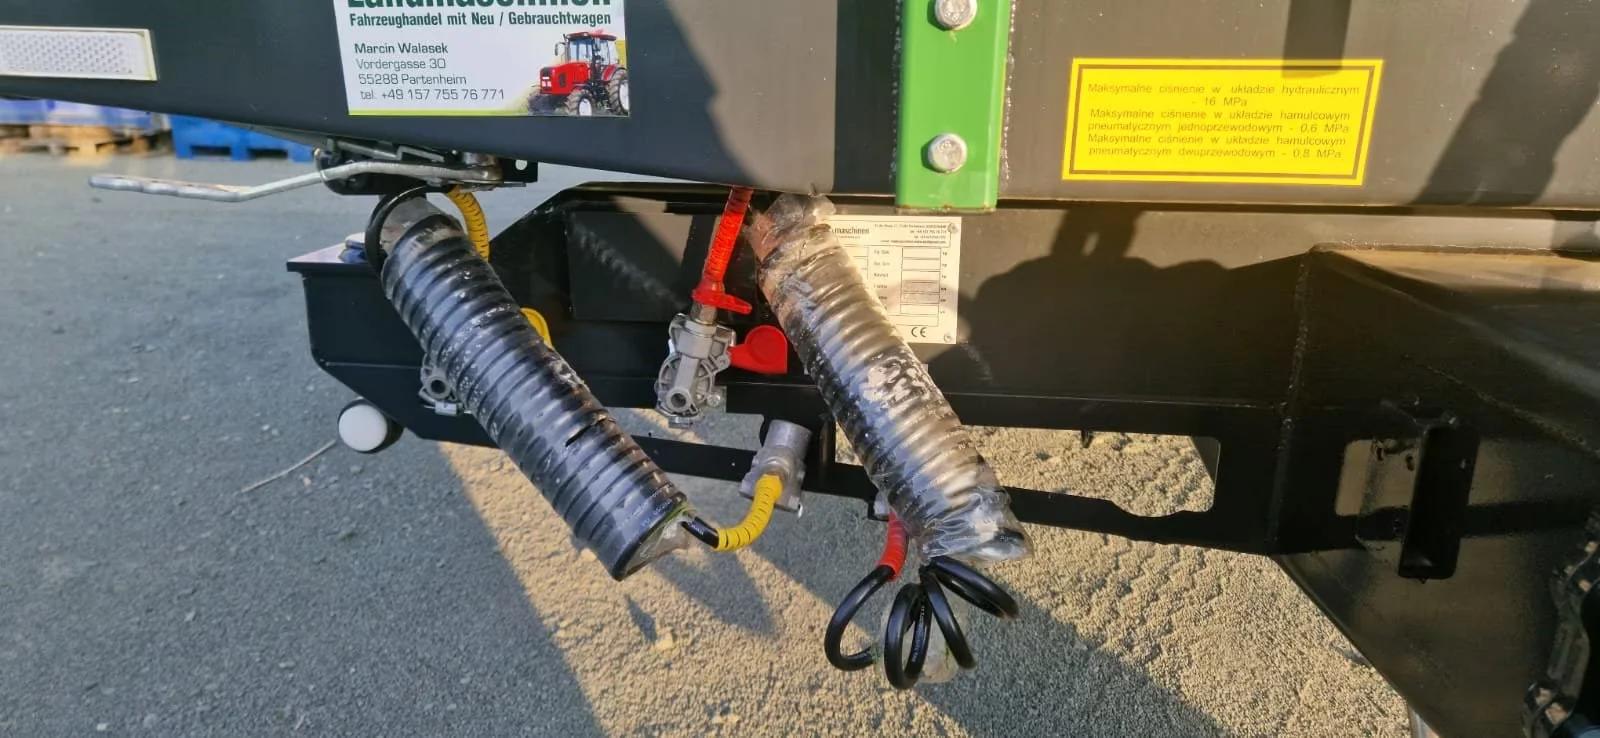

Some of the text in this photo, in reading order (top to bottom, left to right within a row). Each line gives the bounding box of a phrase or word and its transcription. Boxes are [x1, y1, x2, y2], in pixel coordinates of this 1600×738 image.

[349, 11, 611, 28] Fahrzeughandel mit Neu / Gebrauchtwagen
[354, 42, 449, 54] Marcin Walasek
[356, 58, 446, 71] Vordergasse 30
[358, 73, 467, 85] 55288 Partenheim
[381, 88, 404, 100] +49
[408, 88, 430, 100] 157
[435, 88, 458, 100] 755
[461, 88, 478, 100] 76
[482, 88, 505, 100] 771
[1088, 83, 1152, 95] Maksymalne
[1281, 84, 1360, 96] hydraulicznym
[1204, 96, 1216, 106] 16
[1223, 96, 1248, 106] MPa
[1090, 109, 1154, 120] Maksymalne
[1214, 111, 1223, 119] w
[1280, 110, 1350, 122] hamulcowym
[1088, 121, 1171, 132] pneumatycznym
[1178, 122, 1283, 133] jednoprzewodowym
[1323, 123, 1349, 133] MPa
[1088, 133, 1152, 144] Maksymalne
[1276, 135, 1346, 147] hamulcowym
[1088, 146, 1172, 157] pneumatycznym
[1178, 147, 1276, 158] dwuprzewodowym
